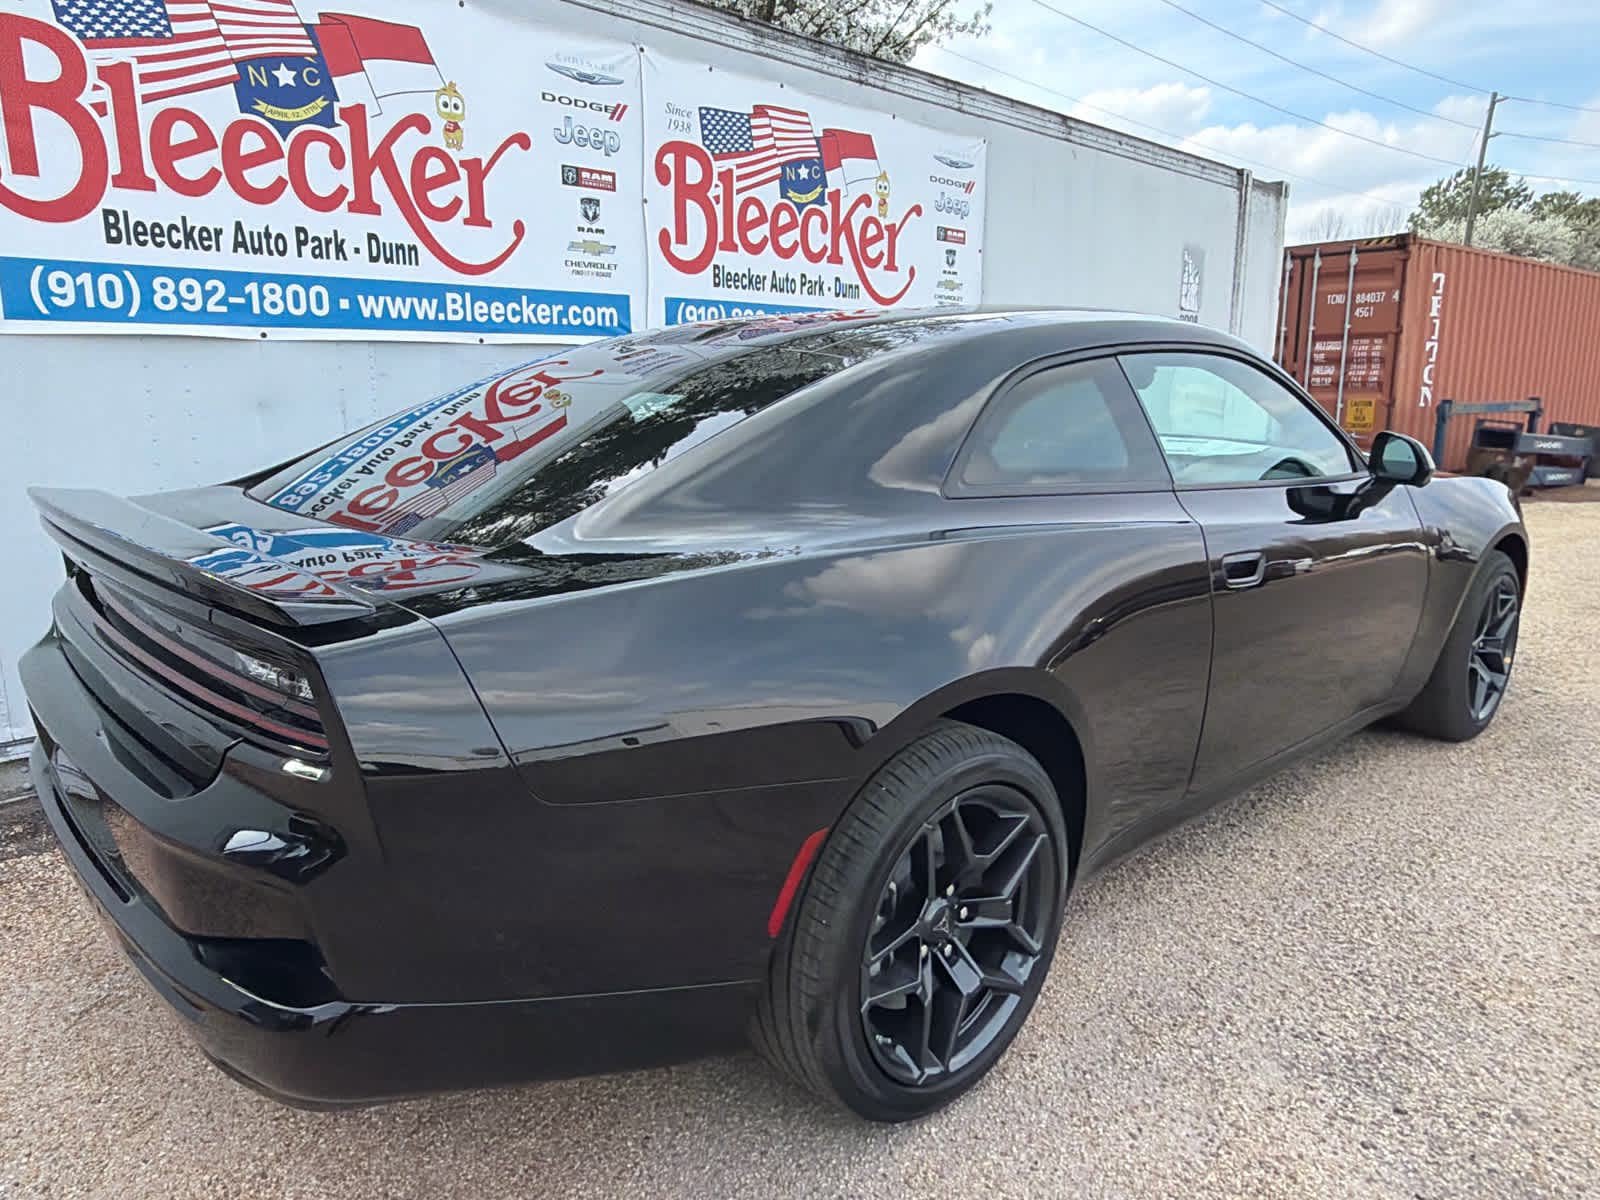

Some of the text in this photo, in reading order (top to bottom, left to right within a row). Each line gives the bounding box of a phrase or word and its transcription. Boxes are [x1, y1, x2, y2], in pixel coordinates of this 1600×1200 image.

[247, 64, 320, 88] N C
[541, 91, 616, 115] DODGE
[665, 102, 692, 119] Since
[553, 115, 621, 157] Jeep
[667, 118, 692, 135] 1938
[0, 12, 531, 276] Bleecker
[581, 171, 613, 184] RAM
[786, 165, 821, 181] N C
[935, 191, 970, 220] Jeep
[577, 226, 605, 235] RAM
[655, 140, 922, 306] Bleecker
[102, 208, 223, 252] Bleecker
[232, 220, 288, 257] Auto
[296, 226, 348, 261] Park
[368, 233, 420, 266] Dunn
[564, 259, 618, 271] CHEVROLET
[712, 264, 768, 292] Bleecker
[770, 270, 797, 294] Auto
[800, 273, 825, 297] Park
[834, 276, 860, 300] Dunn
[30, 265, 618, 328] (910) 892-1800 www.Bleecker.com
[1327, 289, 1400, 305] TCNU 884037 4
